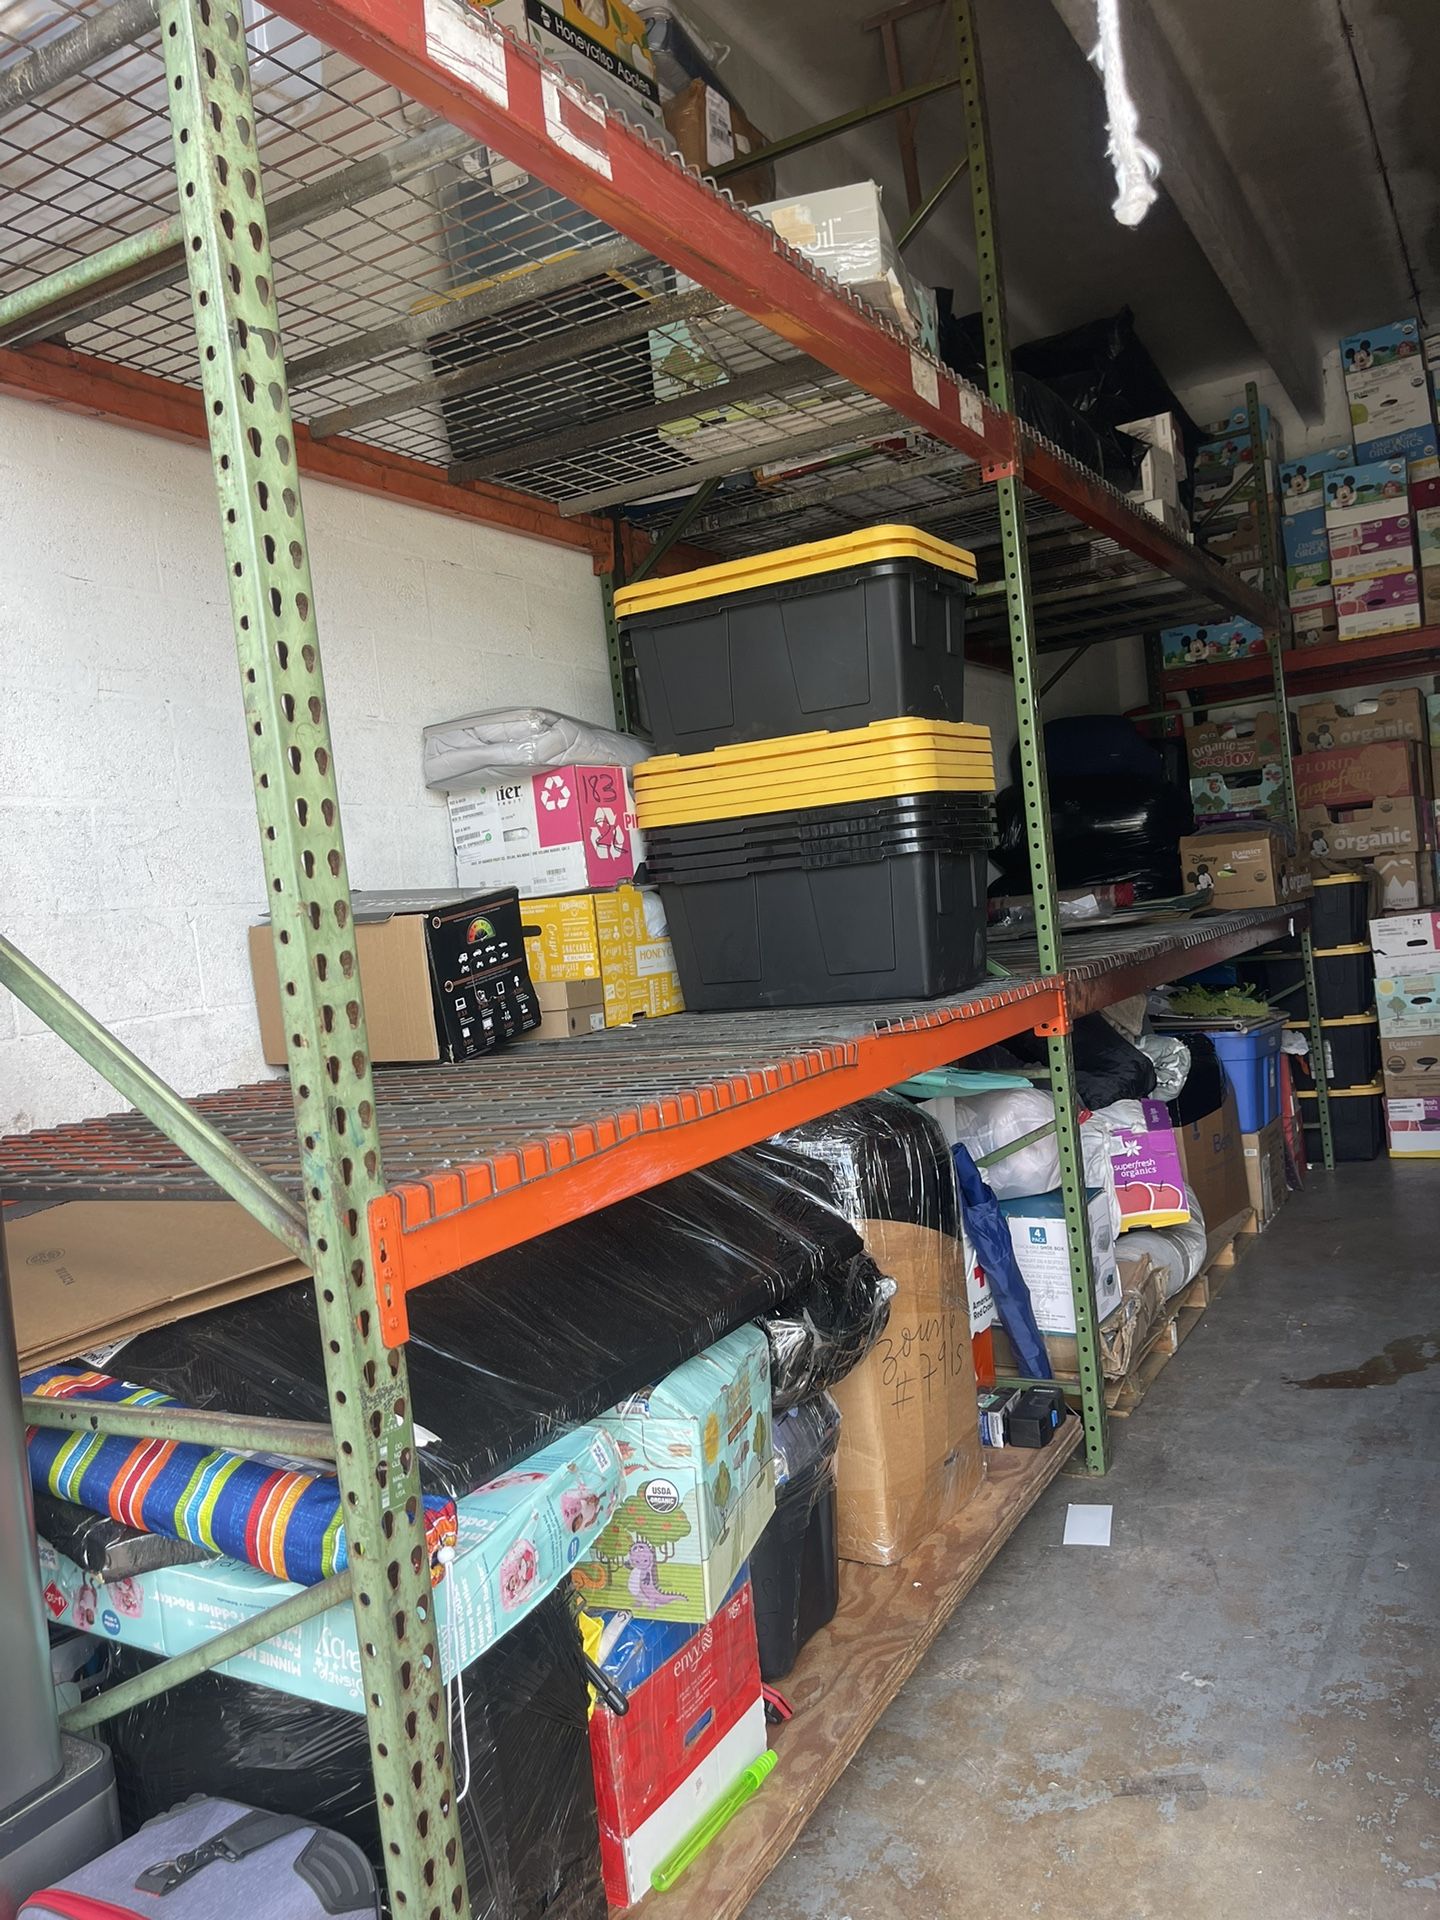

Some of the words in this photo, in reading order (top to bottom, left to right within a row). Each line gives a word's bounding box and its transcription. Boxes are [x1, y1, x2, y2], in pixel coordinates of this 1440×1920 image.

[555, 16, 614, 71] Honeycrisp
[617, 61, 651, 96] Apples
[1340, 718, 1415, 744] organic
[1191, 740, 1237, 758] Organic
[582, 773, 618, 804] 183
[1334, 825, 1413, 851] organic
[1188, 854, 1218, 865] Disney
[1114, 1158, 1156, 1172] superfresh
[1120, 1166, 1157, 1178] organics
[1034, 1228, 1042, 1238] 4
[973, 1309, 983, 1320] Red
[651, 1486, 672, 1496] USDA
[649, 1496, 675, 1505] ORGANIC
[315, 1627, 362, 1672] aby
[254, 1649, 302, 1677] MINNIE
[673, 1645, 704, 1677] envy
